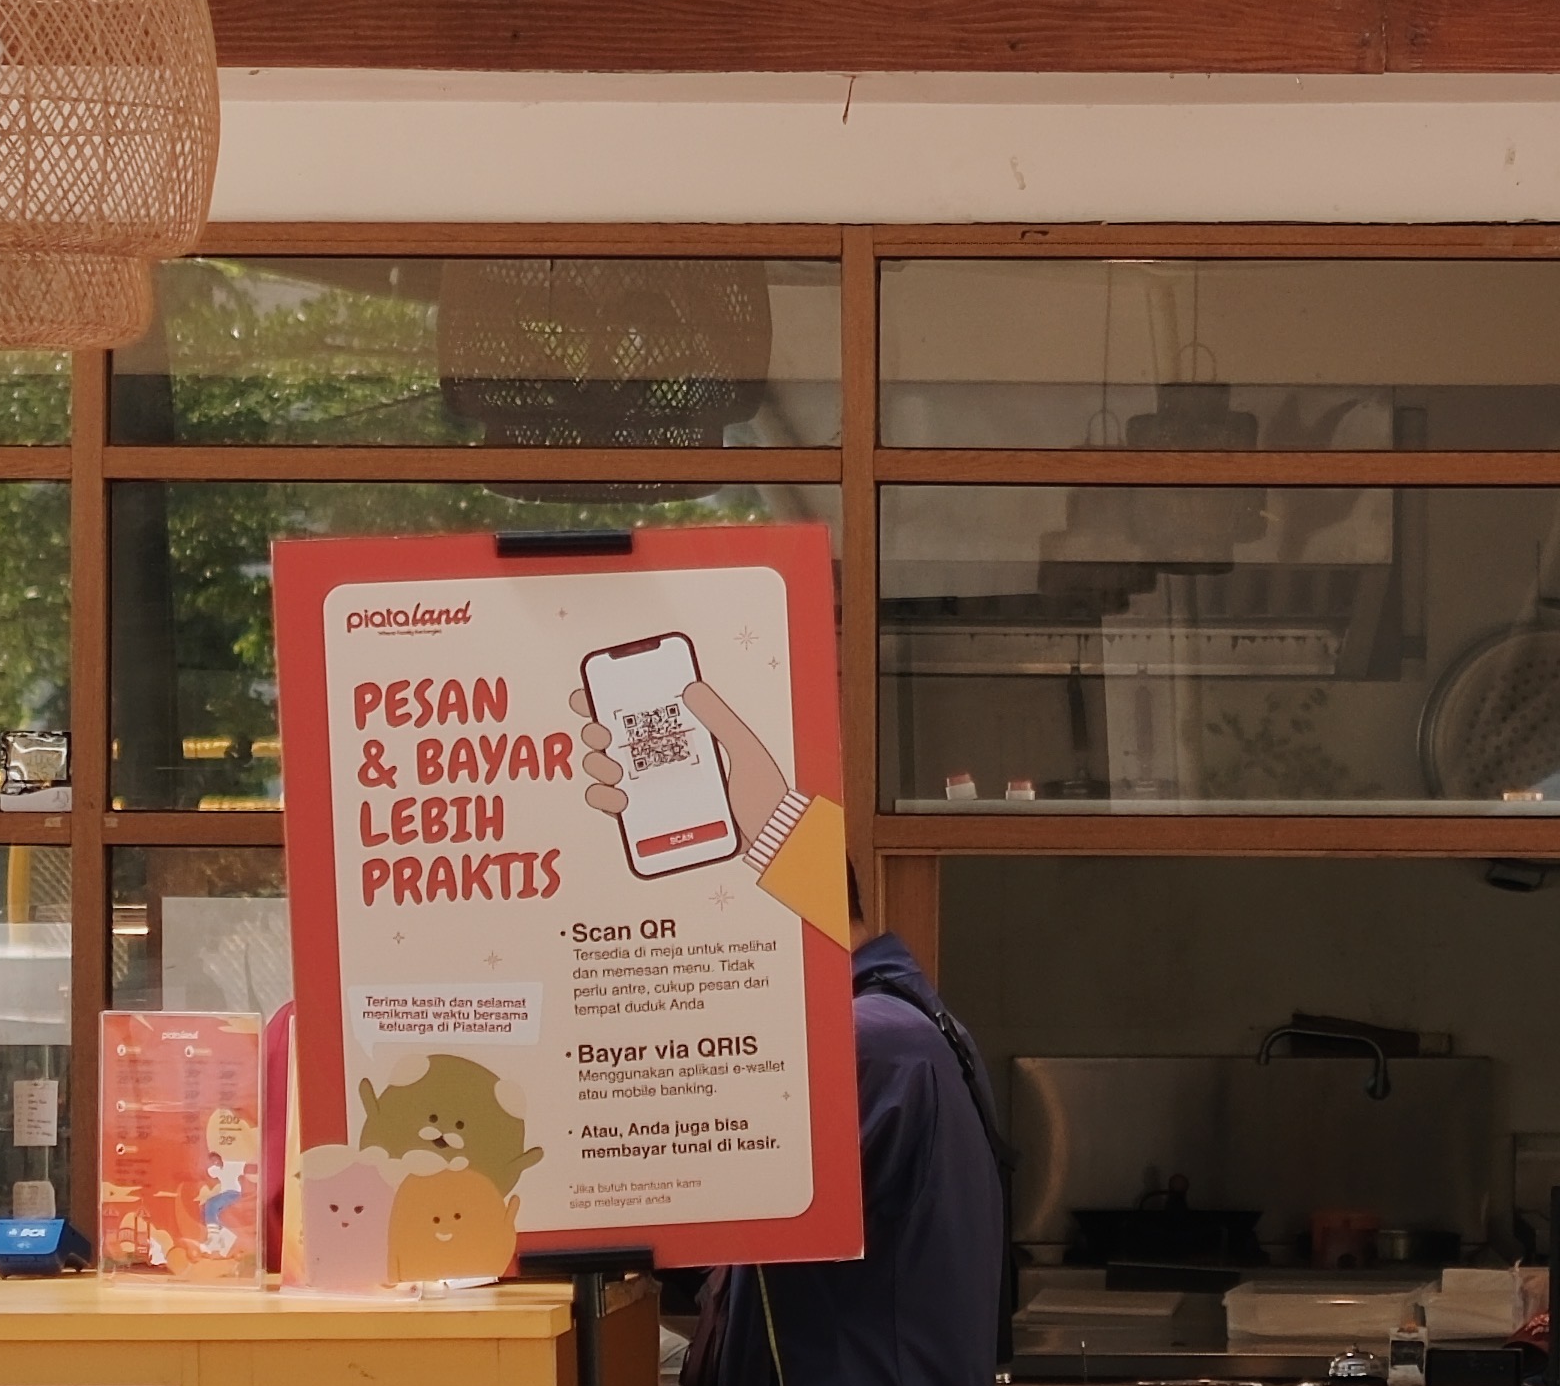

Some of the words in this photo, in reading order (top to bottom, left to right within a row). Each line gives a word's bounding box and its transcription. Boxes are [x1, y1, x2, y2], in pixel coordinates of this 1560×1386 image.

[346, 600, 473, 634] piataland
[353, 676, 509, 731] PESAN
[357, 739, 398, 790] &
[416, 732, 574, 786] BAYAR
[360, 794, 505, 848] LEBIH
[669, 831, 695, 846] SCAN
[362, 847, 562, 907] PRAKTIS
[572, 922, 631, 943] Scan
[639, 919, 677, 941] QR
[573, 947, 630, 961] Tersedia
[634, 946, 646, 958] di
[650, 945, 683, 961] meja
[687, 942, 724, 956] untuk
[728, 940, 778, 954] melihat
[572, 966, 598, 981] dan
[602, 965, 668, 979] memesan
[718, 959, 755, 973] Tidak
[573, 984, 608, 1001] perlu
[611, 983, 651, 997] antre,
[654, 980, 696, 996] cukup
[699, 979, 740, 994] pesan
[743, 976, 770, 989] dari
[365, 996, 408, 1008] Terima
[411, 996, 446, 1008] kasih
[449, 997, 473, 1008] dan
[476, 997, 527, 1008] selamat
[574, 1002, 621, 1018] tempat
[624, 1000, 666, 1014] duduk
[670, 997, 705, 1012] Anda
[362, 1009, 429, 1020] menikmati
[432, 1009, 471, 1021] waktu
[473, 1009, 528, 1021] bersama
[378, 1021, 434, 1035] keluarga
[437, 1022, 449, 1033] di
[453, 1022, 512, 1033] Piataland
[578, 1043, 648, 1068] Bayar
[654, 1039, 690, 1061] via
[696, 1035, 759, 1059] QRIS
[578, 1066, 674, 1083] Menggunakan
[678, 1063, 729, 1079] aplikasi
[732, 1060, 785, 1075] e-wallet
[578, 1088, 608, 1101] atau
[611, 1084, 657, 1098] mobile
[660, 1082, 717, 1099] banking.
[581, 1123, 624, 1140] Atau,
[627, 1121, 670, 1137] Anda
[674, 1119, 710, 1138] juga
[714, 1117, 749, 1132] bisa
[581, 1143, 667, 1160] membayar
[717, 1137, 732, 1152] di
[736, 1135, 781, 1151] kasir.
